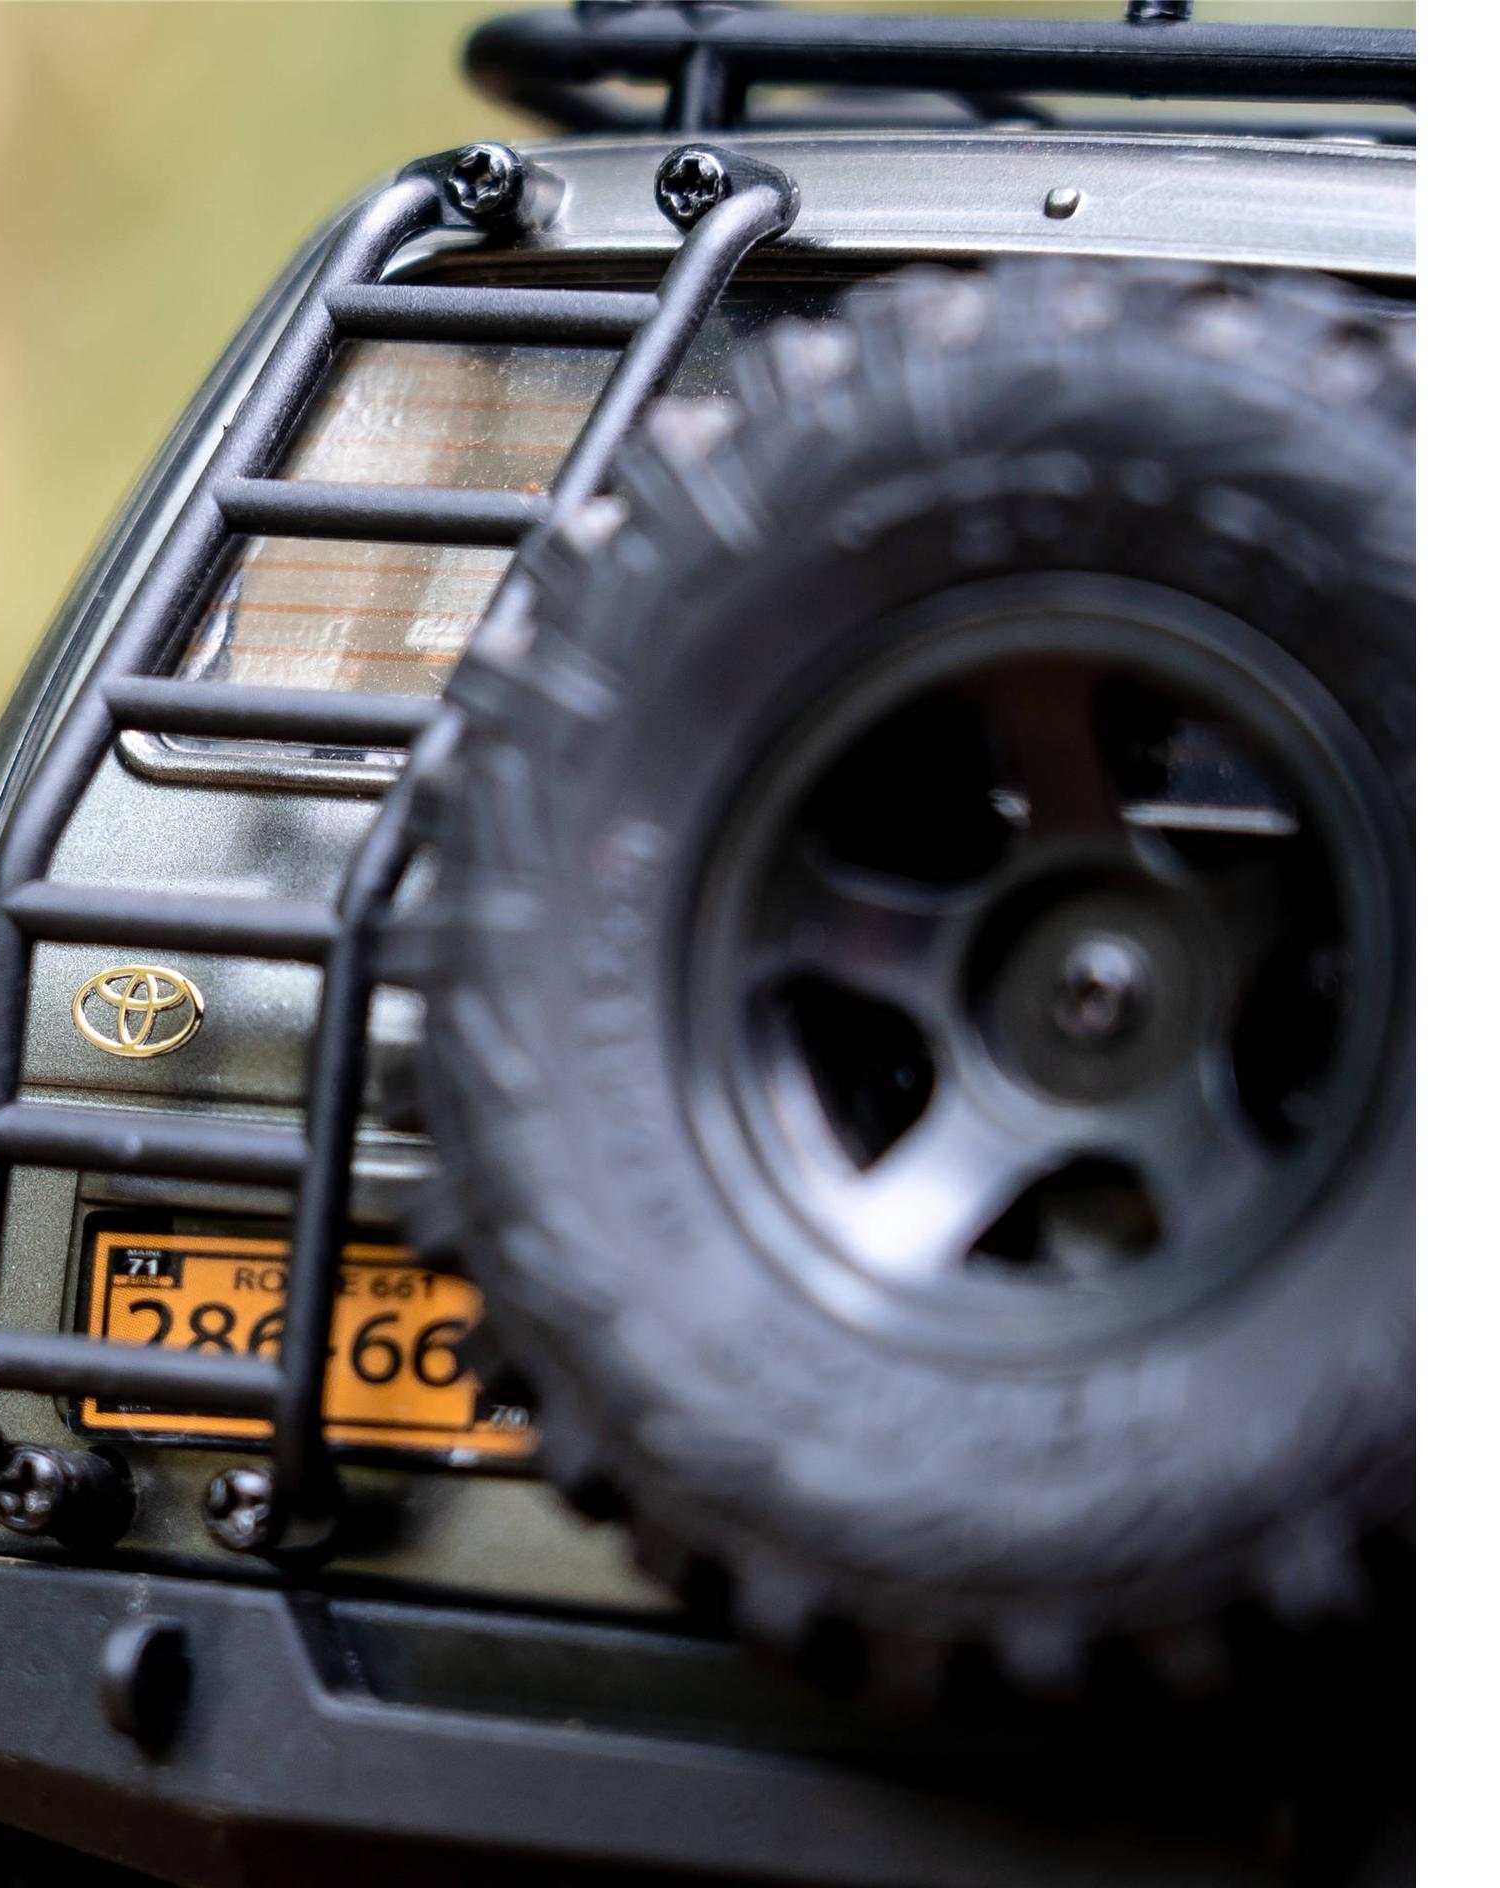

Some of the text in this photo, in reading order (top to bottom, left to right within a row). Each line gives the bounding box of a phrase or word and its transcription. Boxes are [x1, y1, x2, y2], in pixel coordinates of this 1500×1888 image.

[128, 1258, 158, 1277] 71
[234, 1266, 435, 1299] ROE 661
